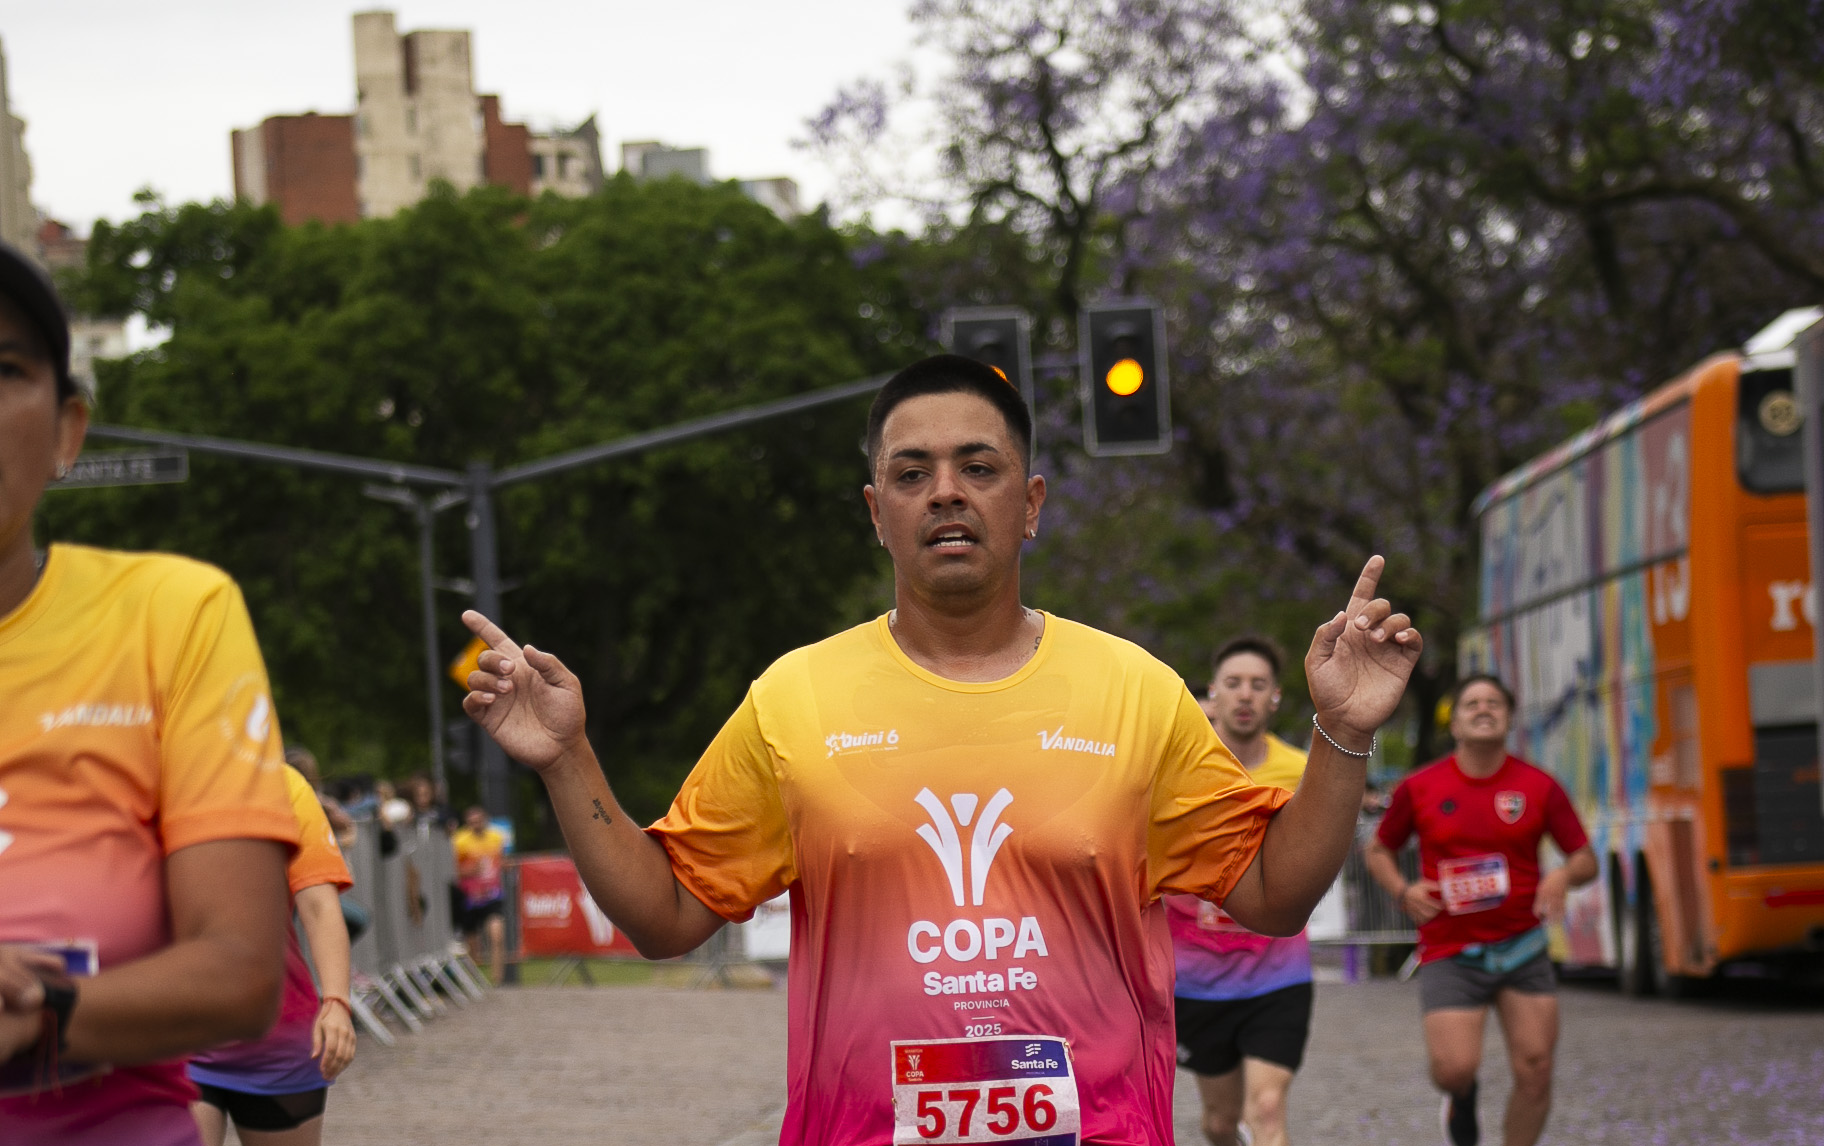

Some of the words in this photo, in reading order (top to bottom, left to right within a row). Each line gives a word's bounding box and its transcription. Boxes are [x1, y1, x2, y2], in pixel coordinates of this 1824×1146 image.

[887, 728, 899, 744] 6
[1037, 725, 1116, 757] VANDALIA
[907, 916, 1048, 963] COPA
[923, 971, 1004, 996] Santa
[1007, 967, 1037, 991] Fe
[953, 998, 1010, 1011] PROVINCIA
[965, 1023, 1002, 1038] 2025
[1011, 1059, 1045, 1069] Santa
[1045, 1058, 1058, 1069] Fe
[906, 1070, 925, 1078] COPA
[916, 1083, 1058, 1139] 5756
